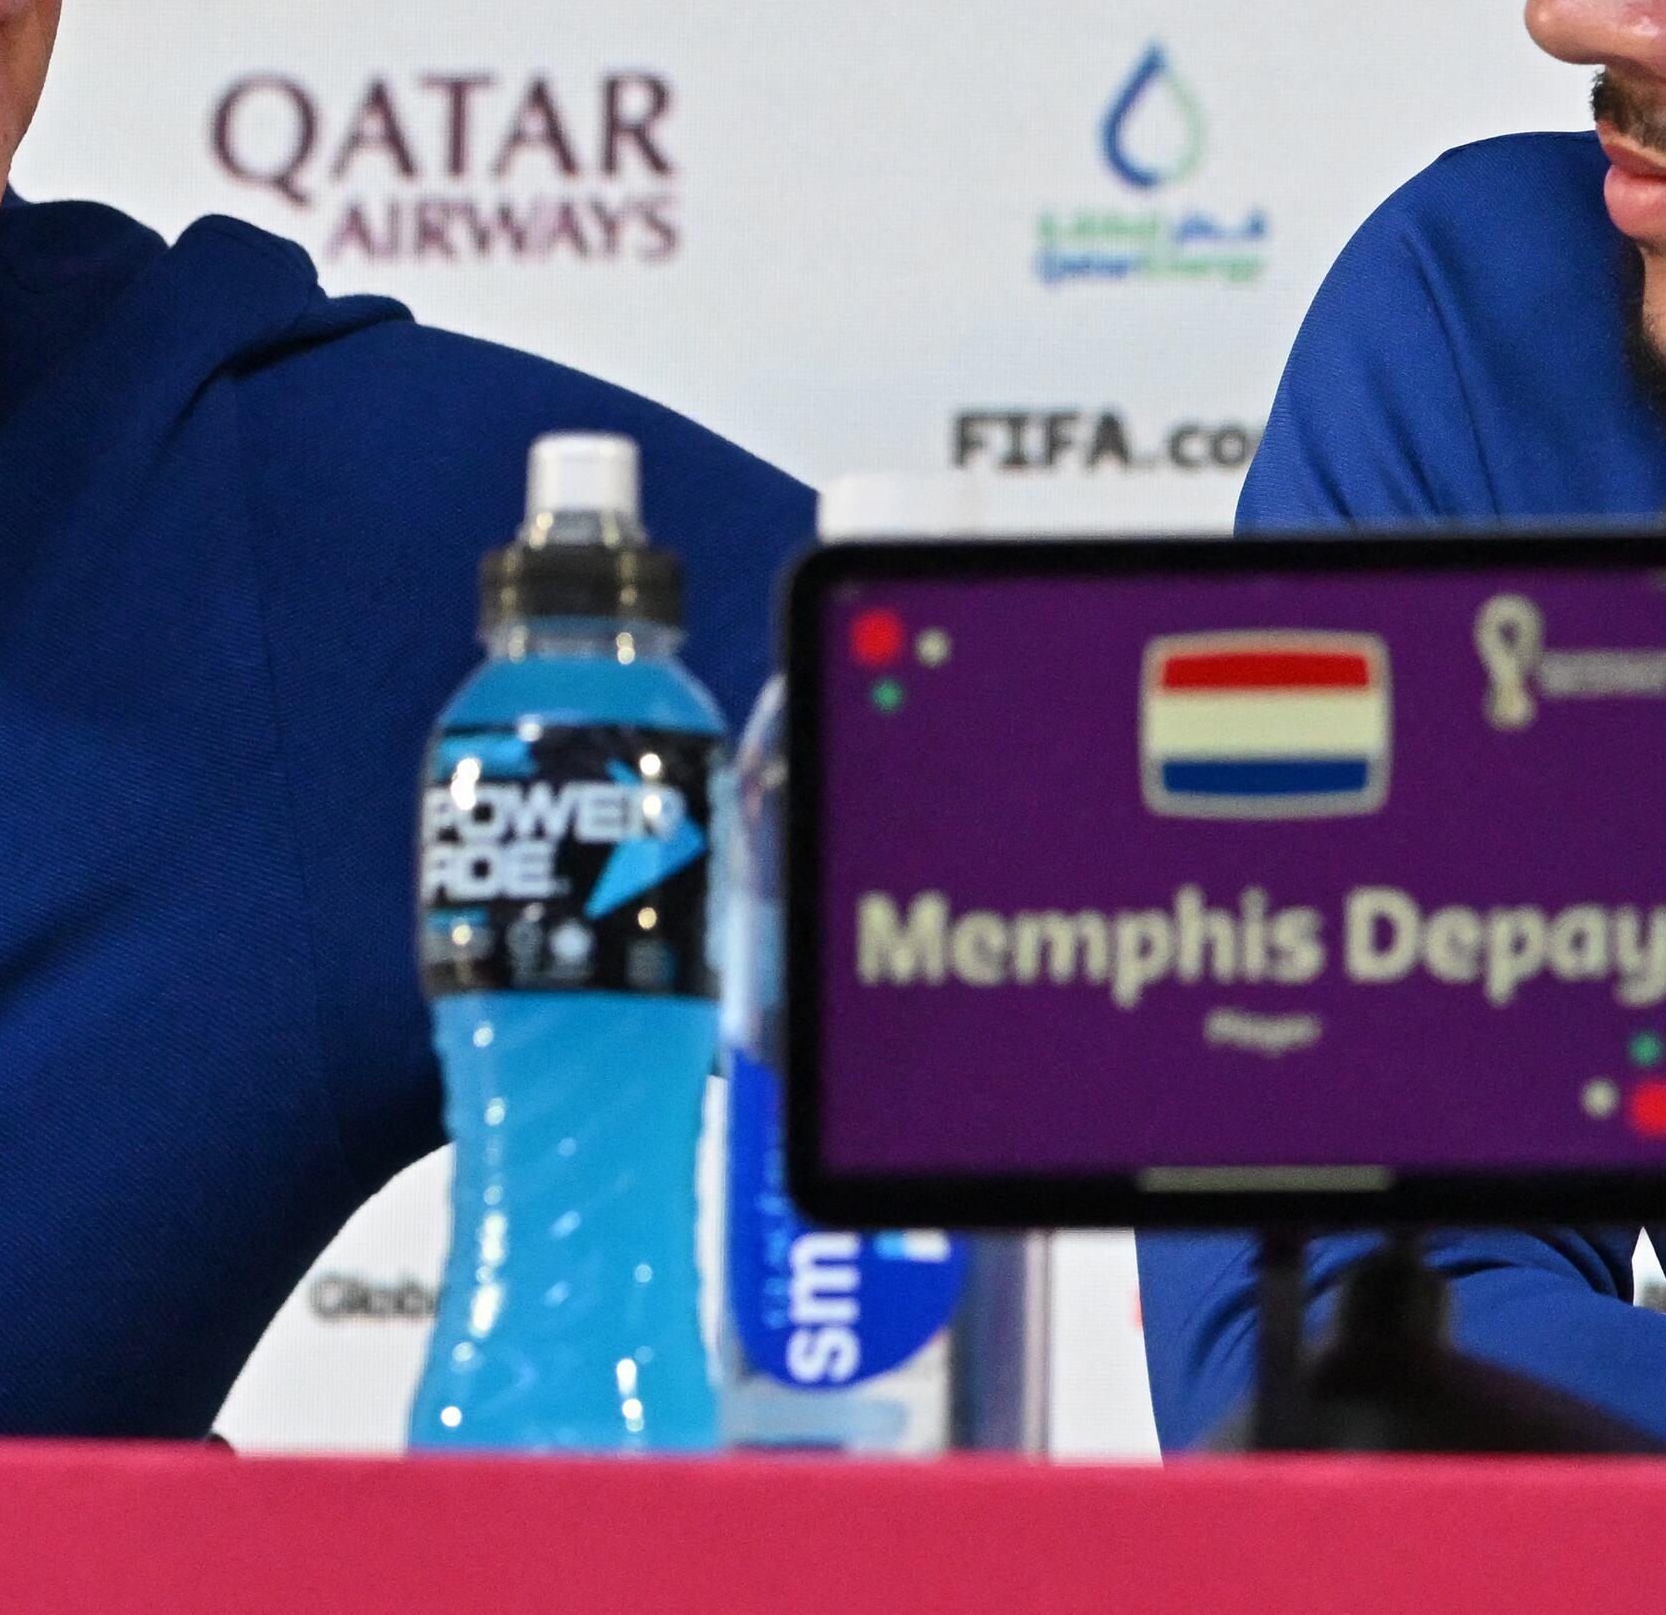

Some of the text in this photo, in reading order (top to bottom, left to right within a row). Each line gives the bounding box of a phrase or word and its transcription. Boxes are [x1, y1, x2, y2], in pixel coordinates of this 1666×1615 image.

[211, 72, 679, 208] QATAR
[330, 193, 680, 261] AIRWAYS
[420, 782, 687, 844] POWER
[855, 885, 1325, 1009] Memphis
